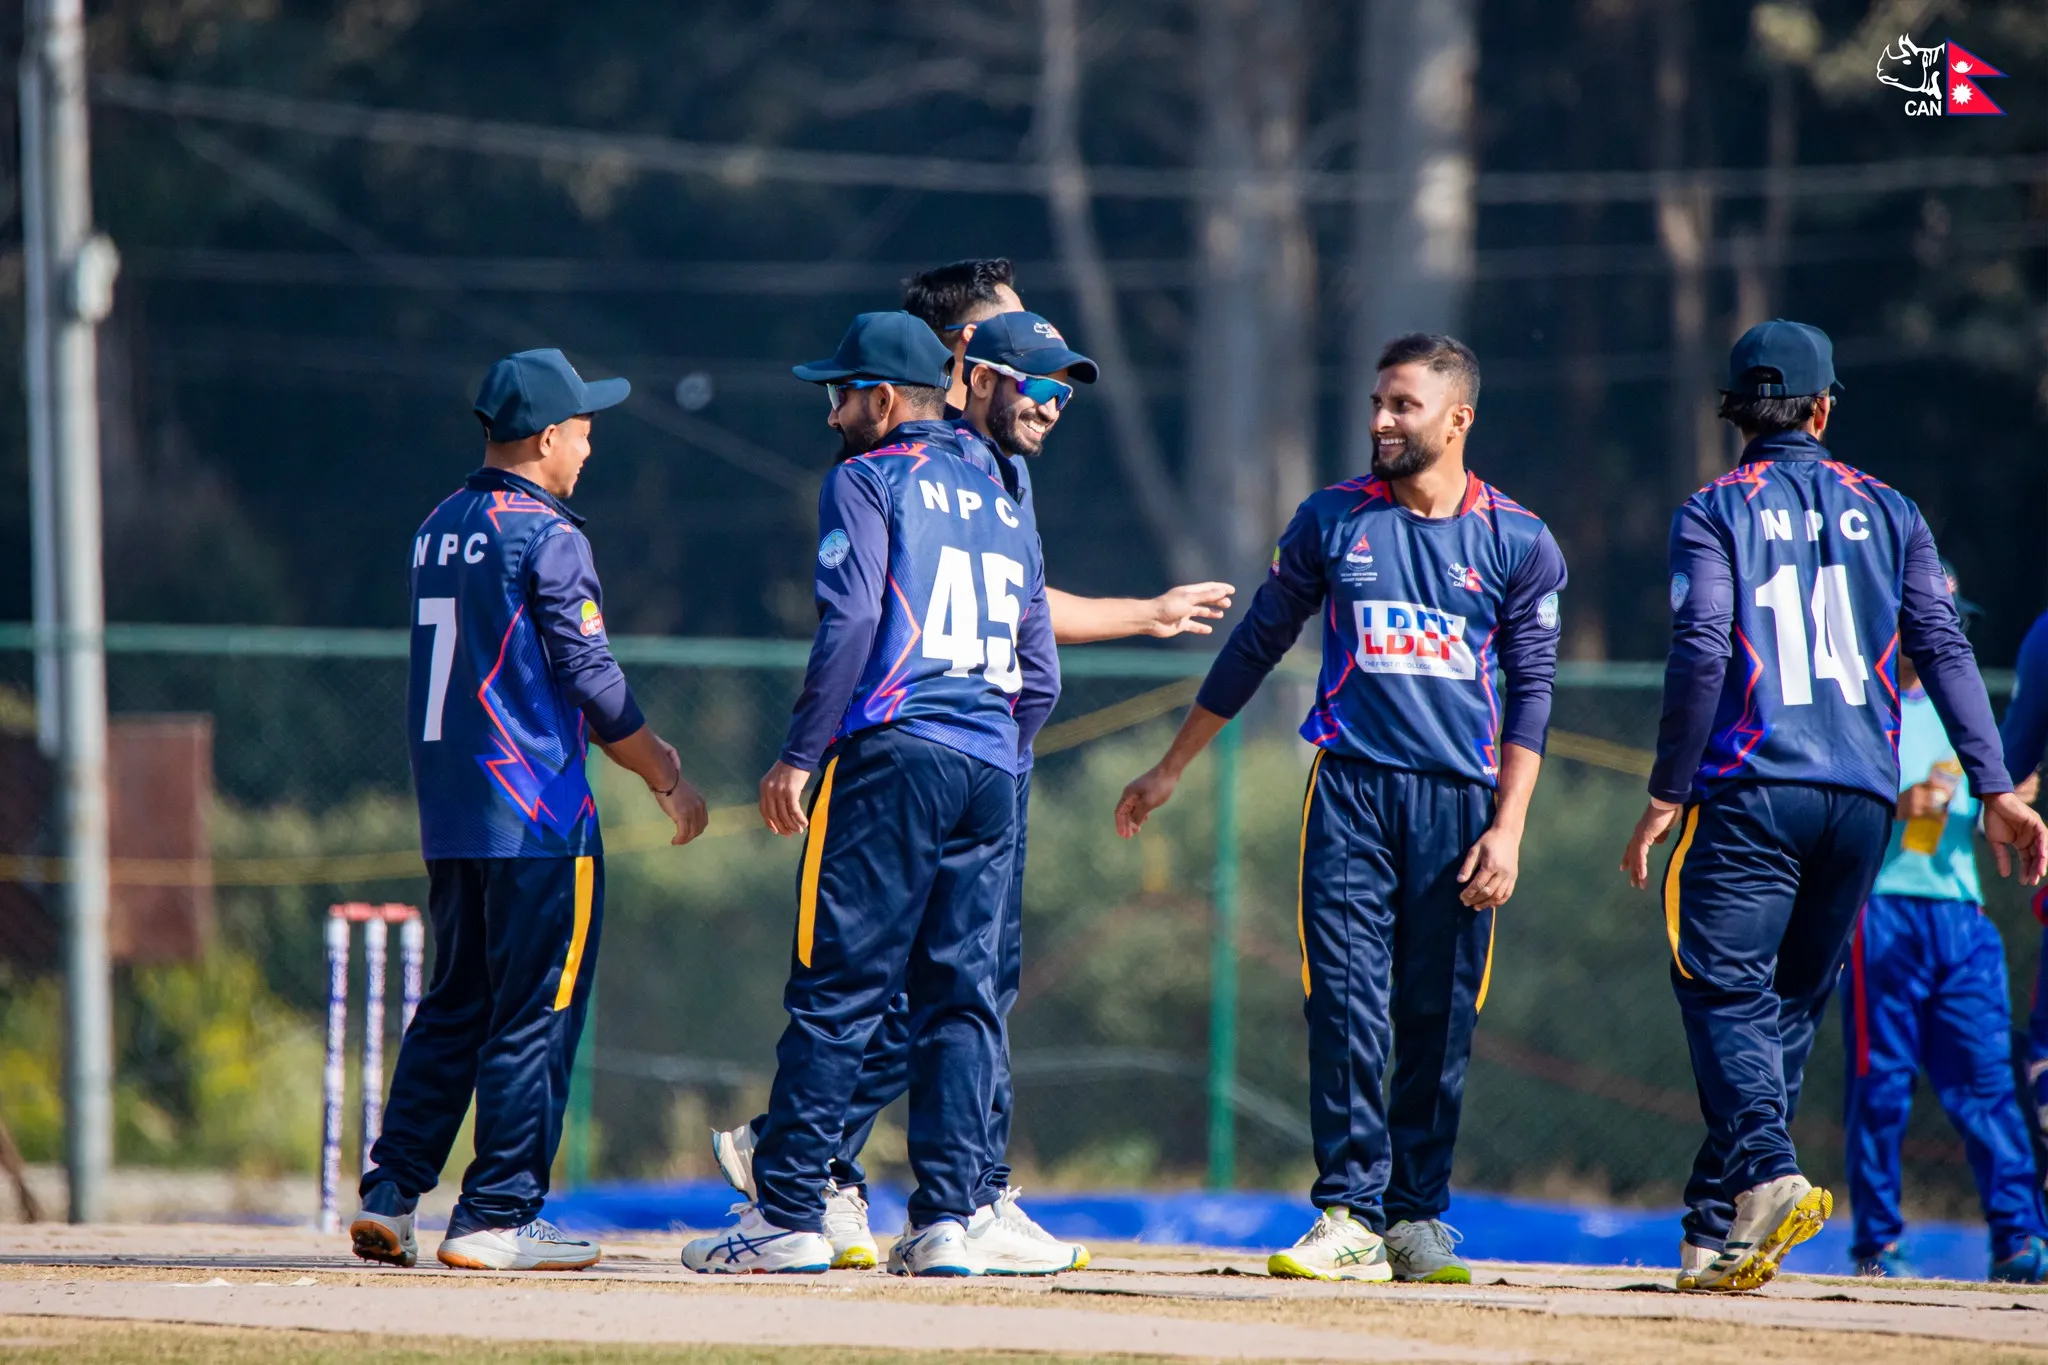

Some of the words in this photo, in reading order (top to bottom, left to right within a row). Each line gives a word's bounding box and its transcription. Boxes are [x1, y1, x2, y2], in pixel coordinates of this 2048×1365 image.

[418, 597, 456, 741] 7
[922, 545, 1024, 694] 45
[1755, 565, 1870, 706] 14
